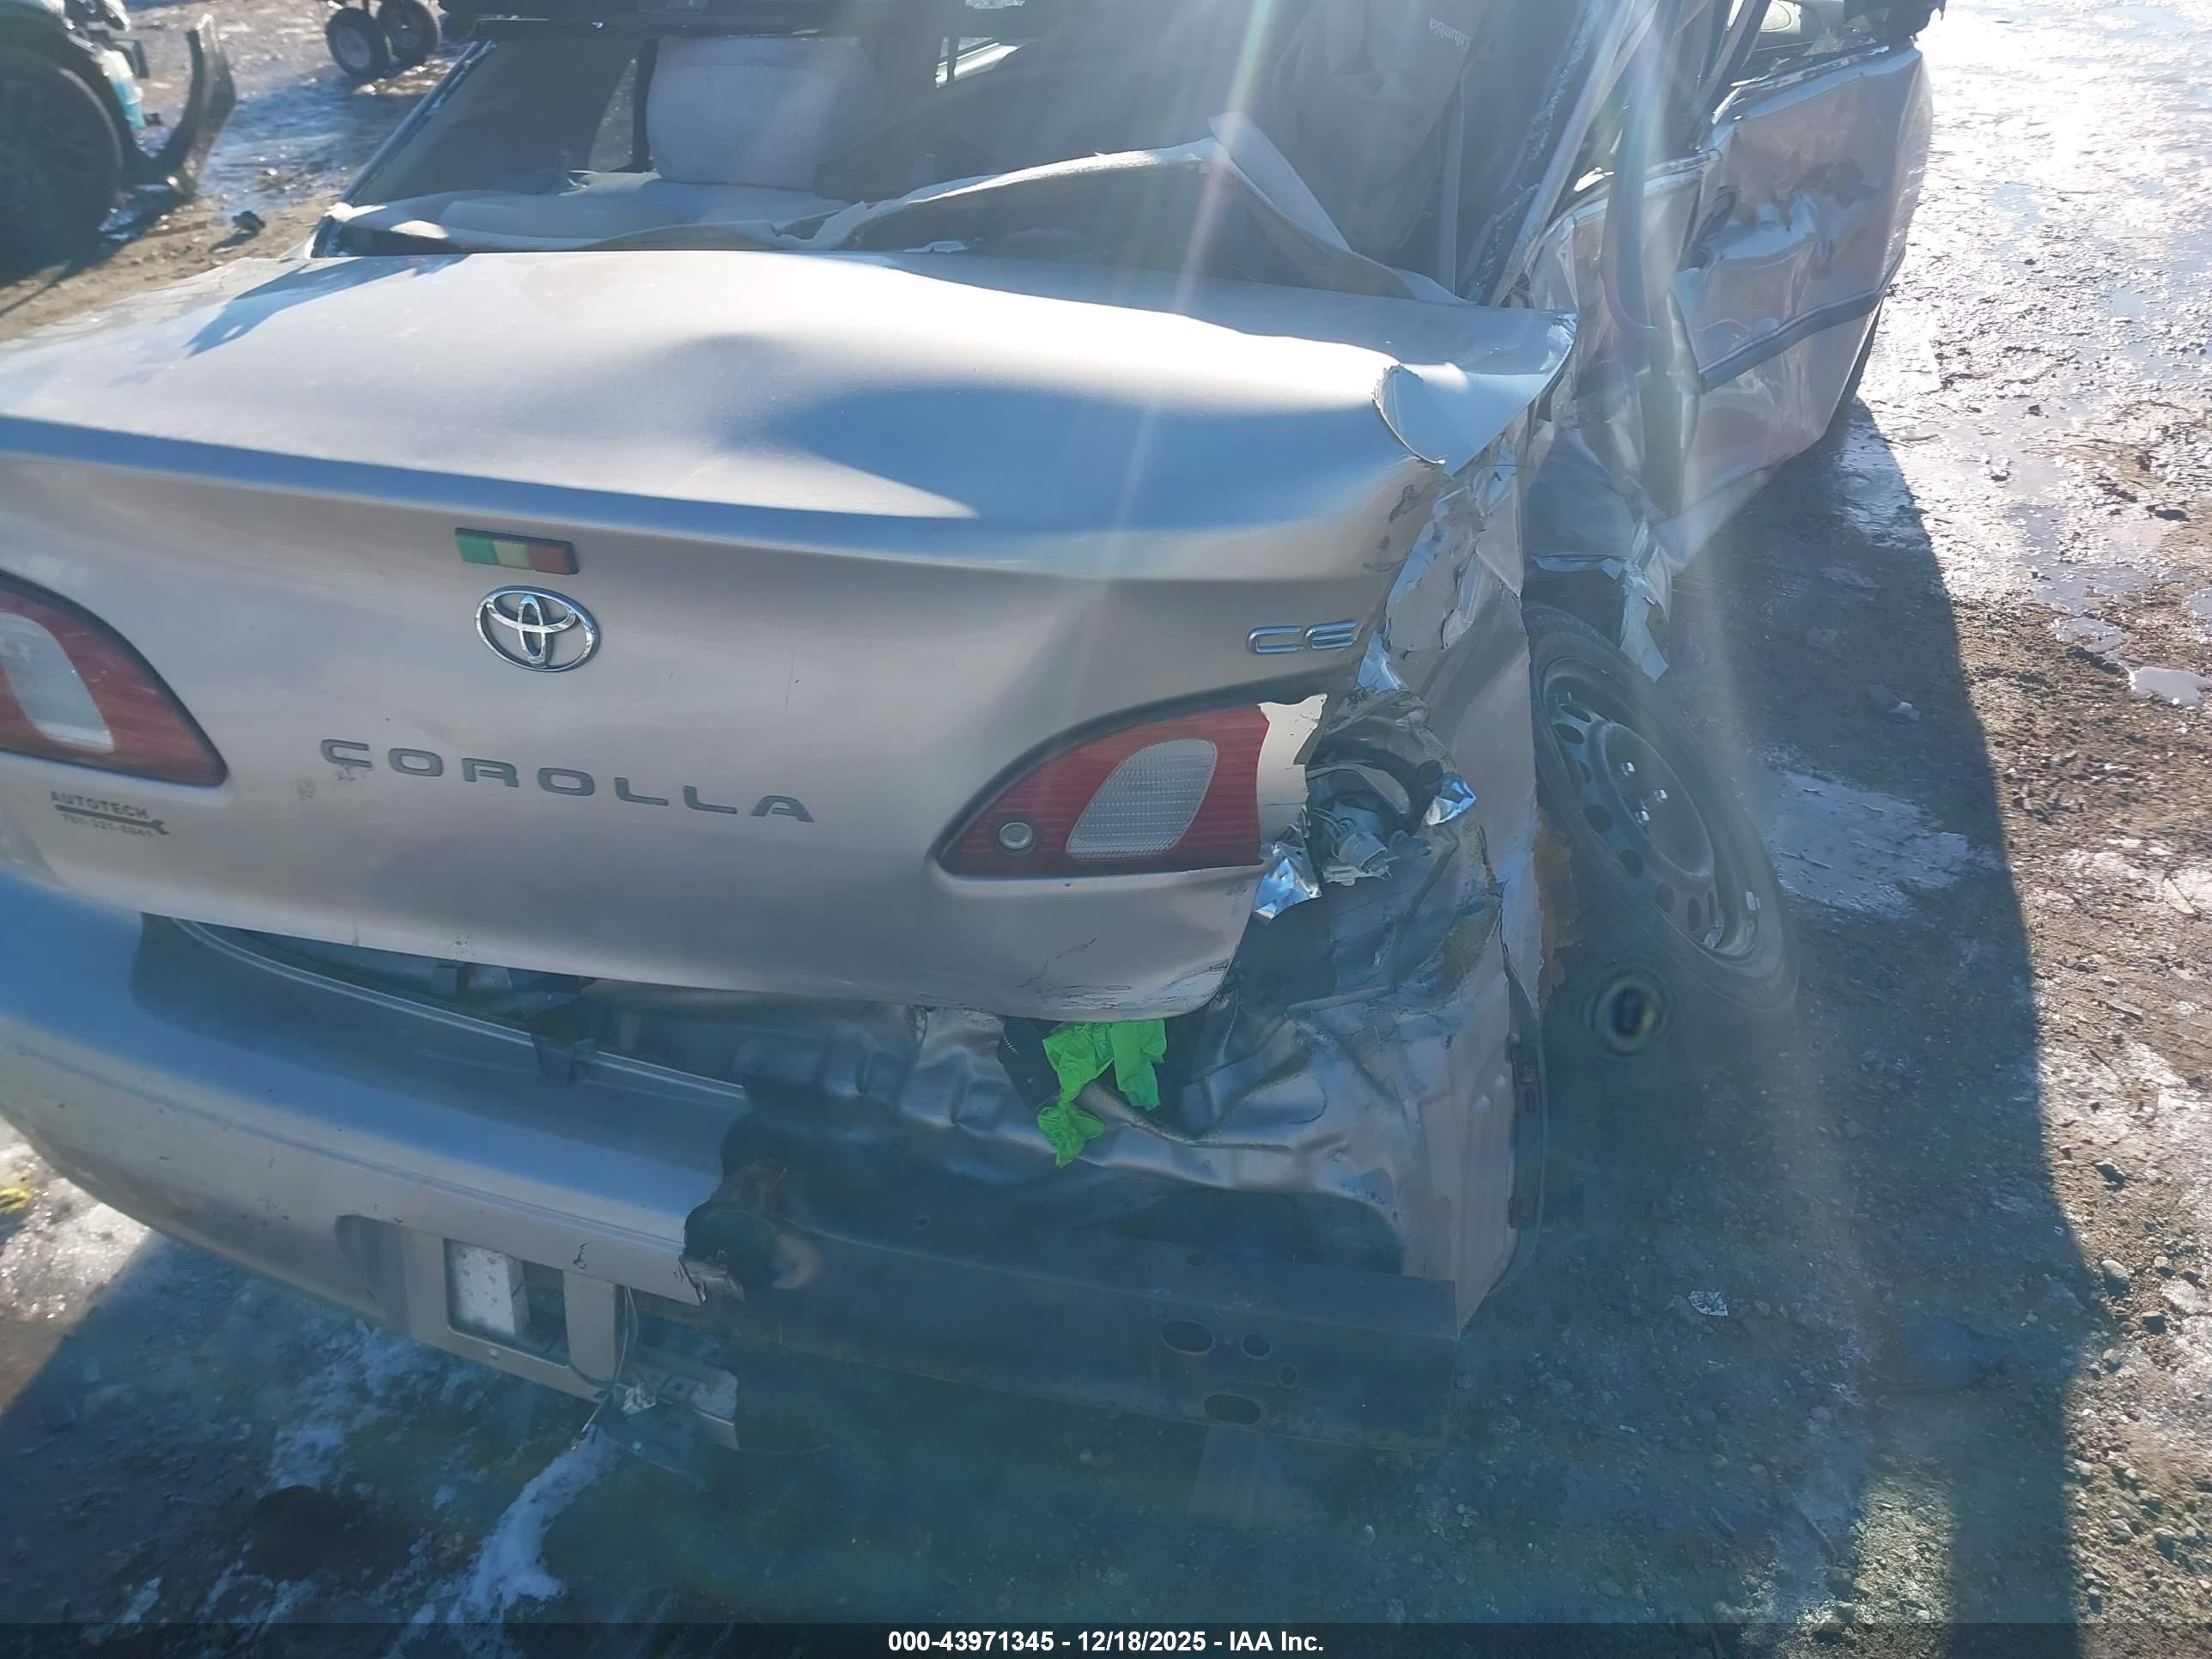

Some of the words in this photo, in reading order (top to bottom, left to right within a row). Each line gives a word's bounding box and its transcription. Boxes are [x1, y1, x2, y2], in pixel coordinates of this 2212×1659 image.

[1246, 619, 1358, 655] CE
[320, 738, 815, 823] COROLLA
[51, 791, 149, 819] AUTOTECH
